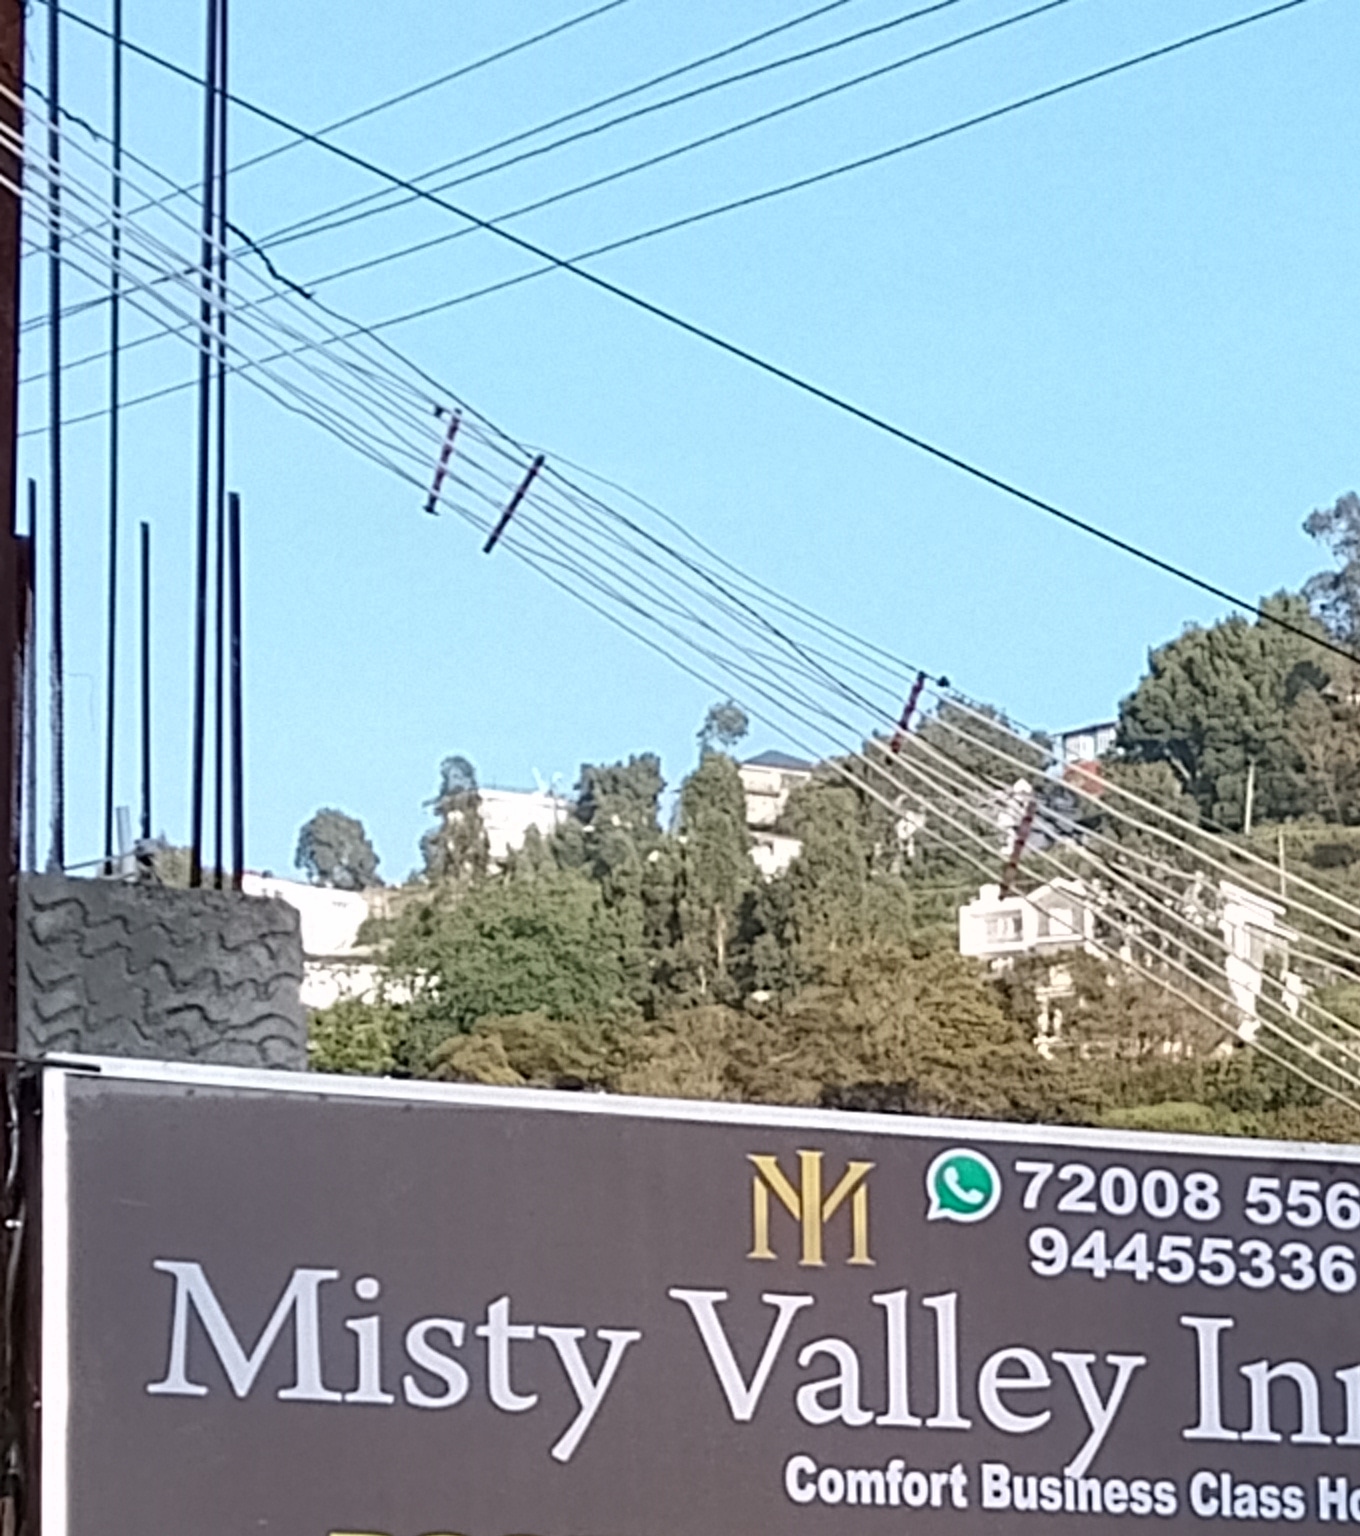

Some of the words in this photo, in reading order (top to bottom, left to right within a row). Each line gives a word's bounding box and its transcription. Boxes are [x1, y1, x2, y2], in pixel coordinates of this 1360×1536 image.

[1014, 1161, 1221, 1221] 72008
[147, 1259, 642, 1464] Misty
[669, 1286, 1147, 1480] Valley
[785, 1455, 967, 1509] Comfort
[980, 1463, 1178, 1517] Business
[1190, 1471, 1306, 1521] Class
